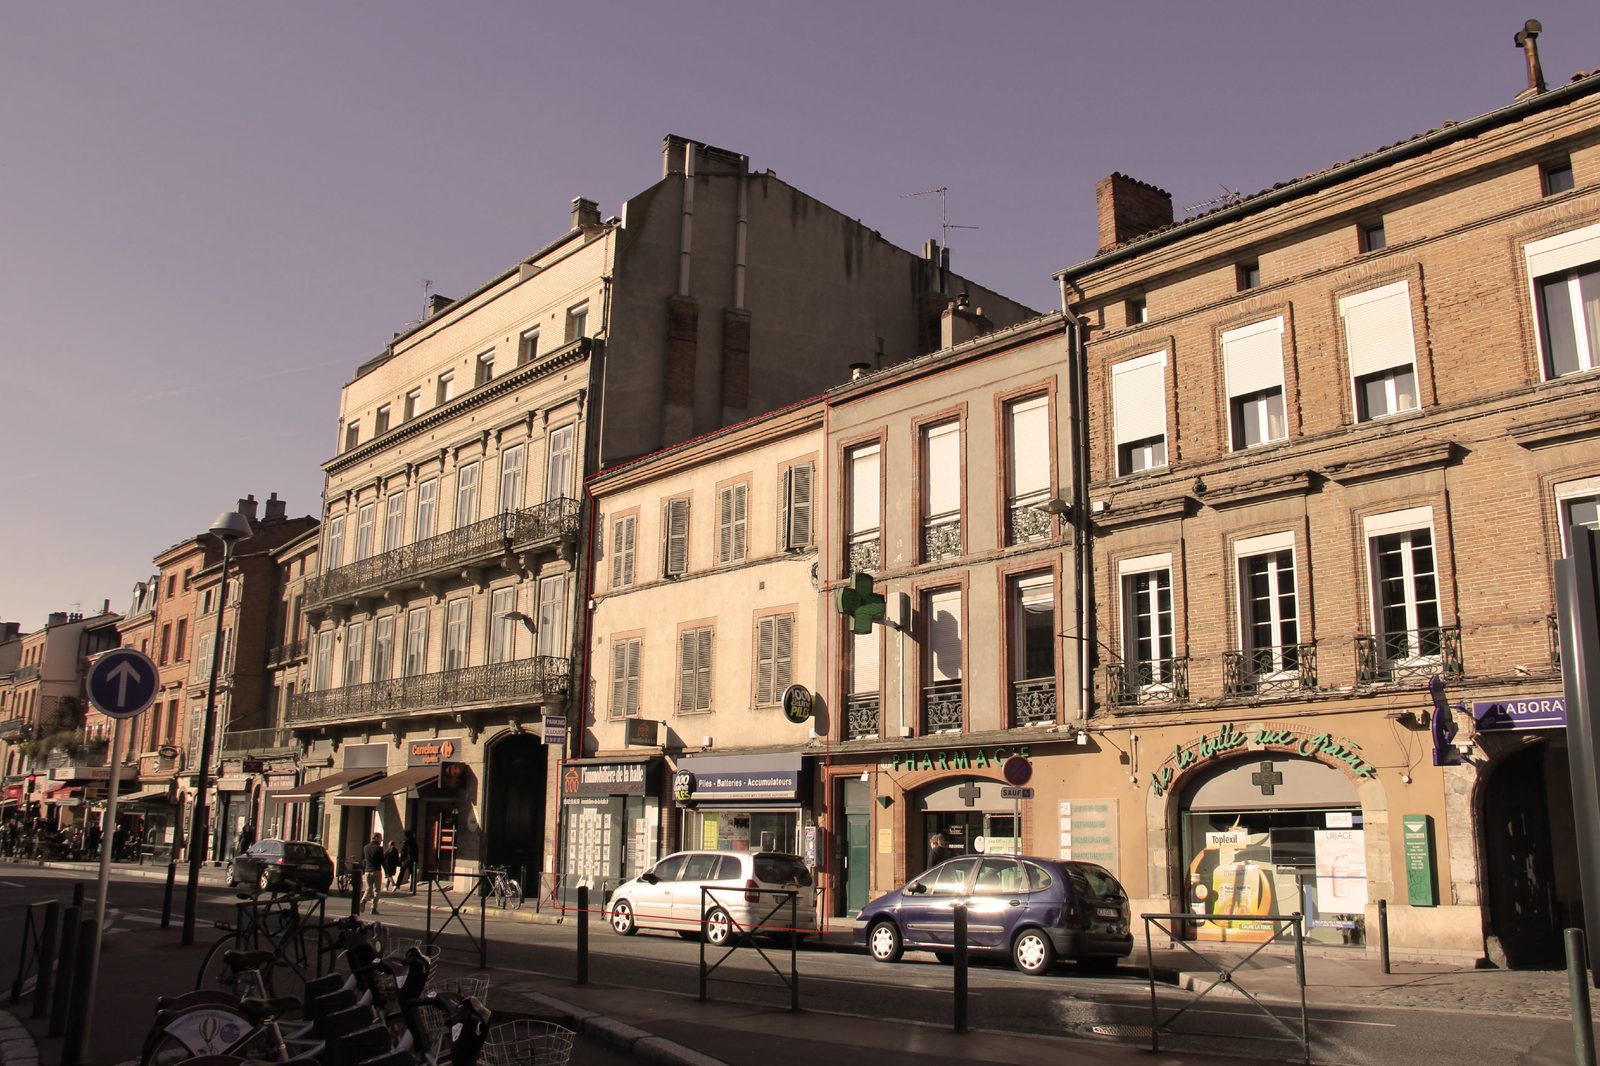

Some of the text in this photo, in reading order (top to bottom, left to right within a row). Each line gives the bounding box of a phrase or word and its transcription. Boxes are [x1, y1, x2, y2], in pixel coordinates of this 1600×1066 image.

[1496, 699, 1565, 716] LABORA
[546, 718, 566, 727] PARKING
[1198, 723, 1247, 758] halle
[1254, 729, 1297, 746] aux
[891, 746, 1030, 771] PHARMACE
[630, 764, 644, 782] halle
[698, 779, 712, 788] Piles
[717, 778, 743, 787] Batteries
[747, 777, 793, 787] Accumulateurs
[1002, 789, 1022, 797] SAUF
[1211, 834, 1238, 846] Toplexil
[1325, 831, 1353, 840] URIAGE
